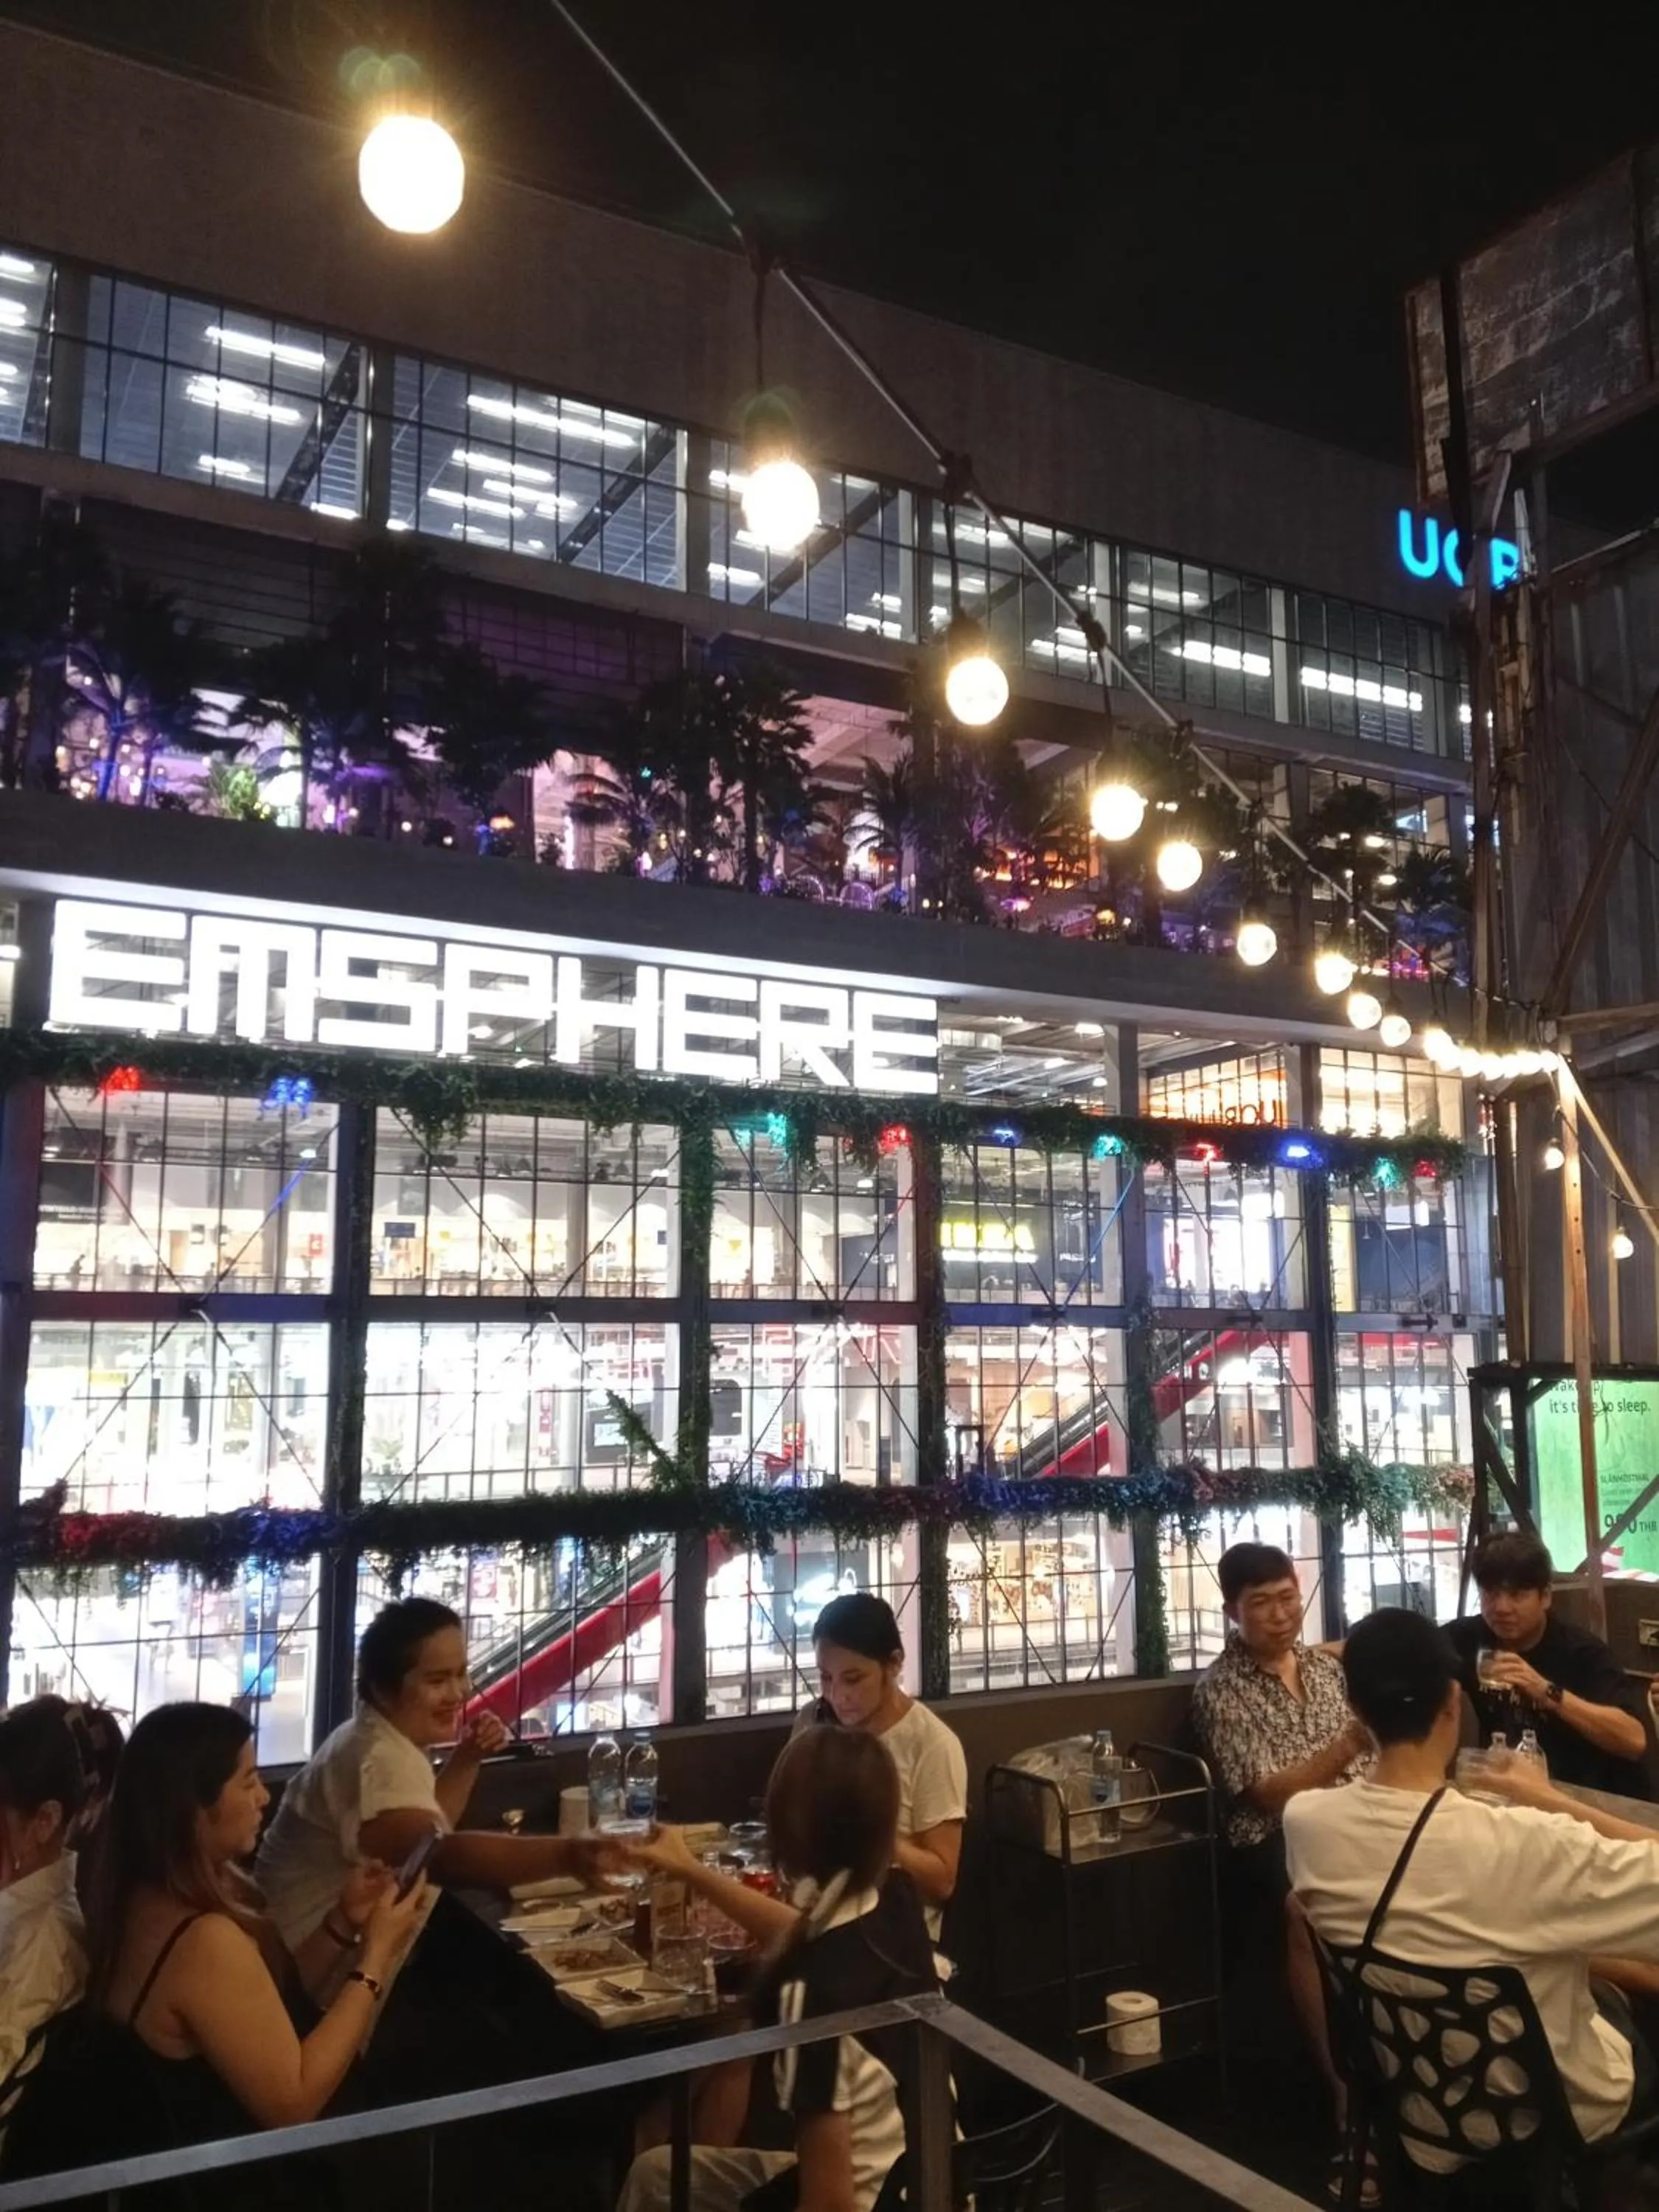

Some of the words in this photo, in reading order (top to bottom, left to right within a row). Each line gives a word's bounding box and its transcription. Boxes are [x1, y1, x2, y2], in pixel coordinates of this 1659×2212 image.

[49, 899, 939, 1096] EMSPHERE
[1549, 1398, 1569, 1413] it's
[1571, 1400, 1599, 1413] te
[1617, 1398, 1651, 1416] sleep.
